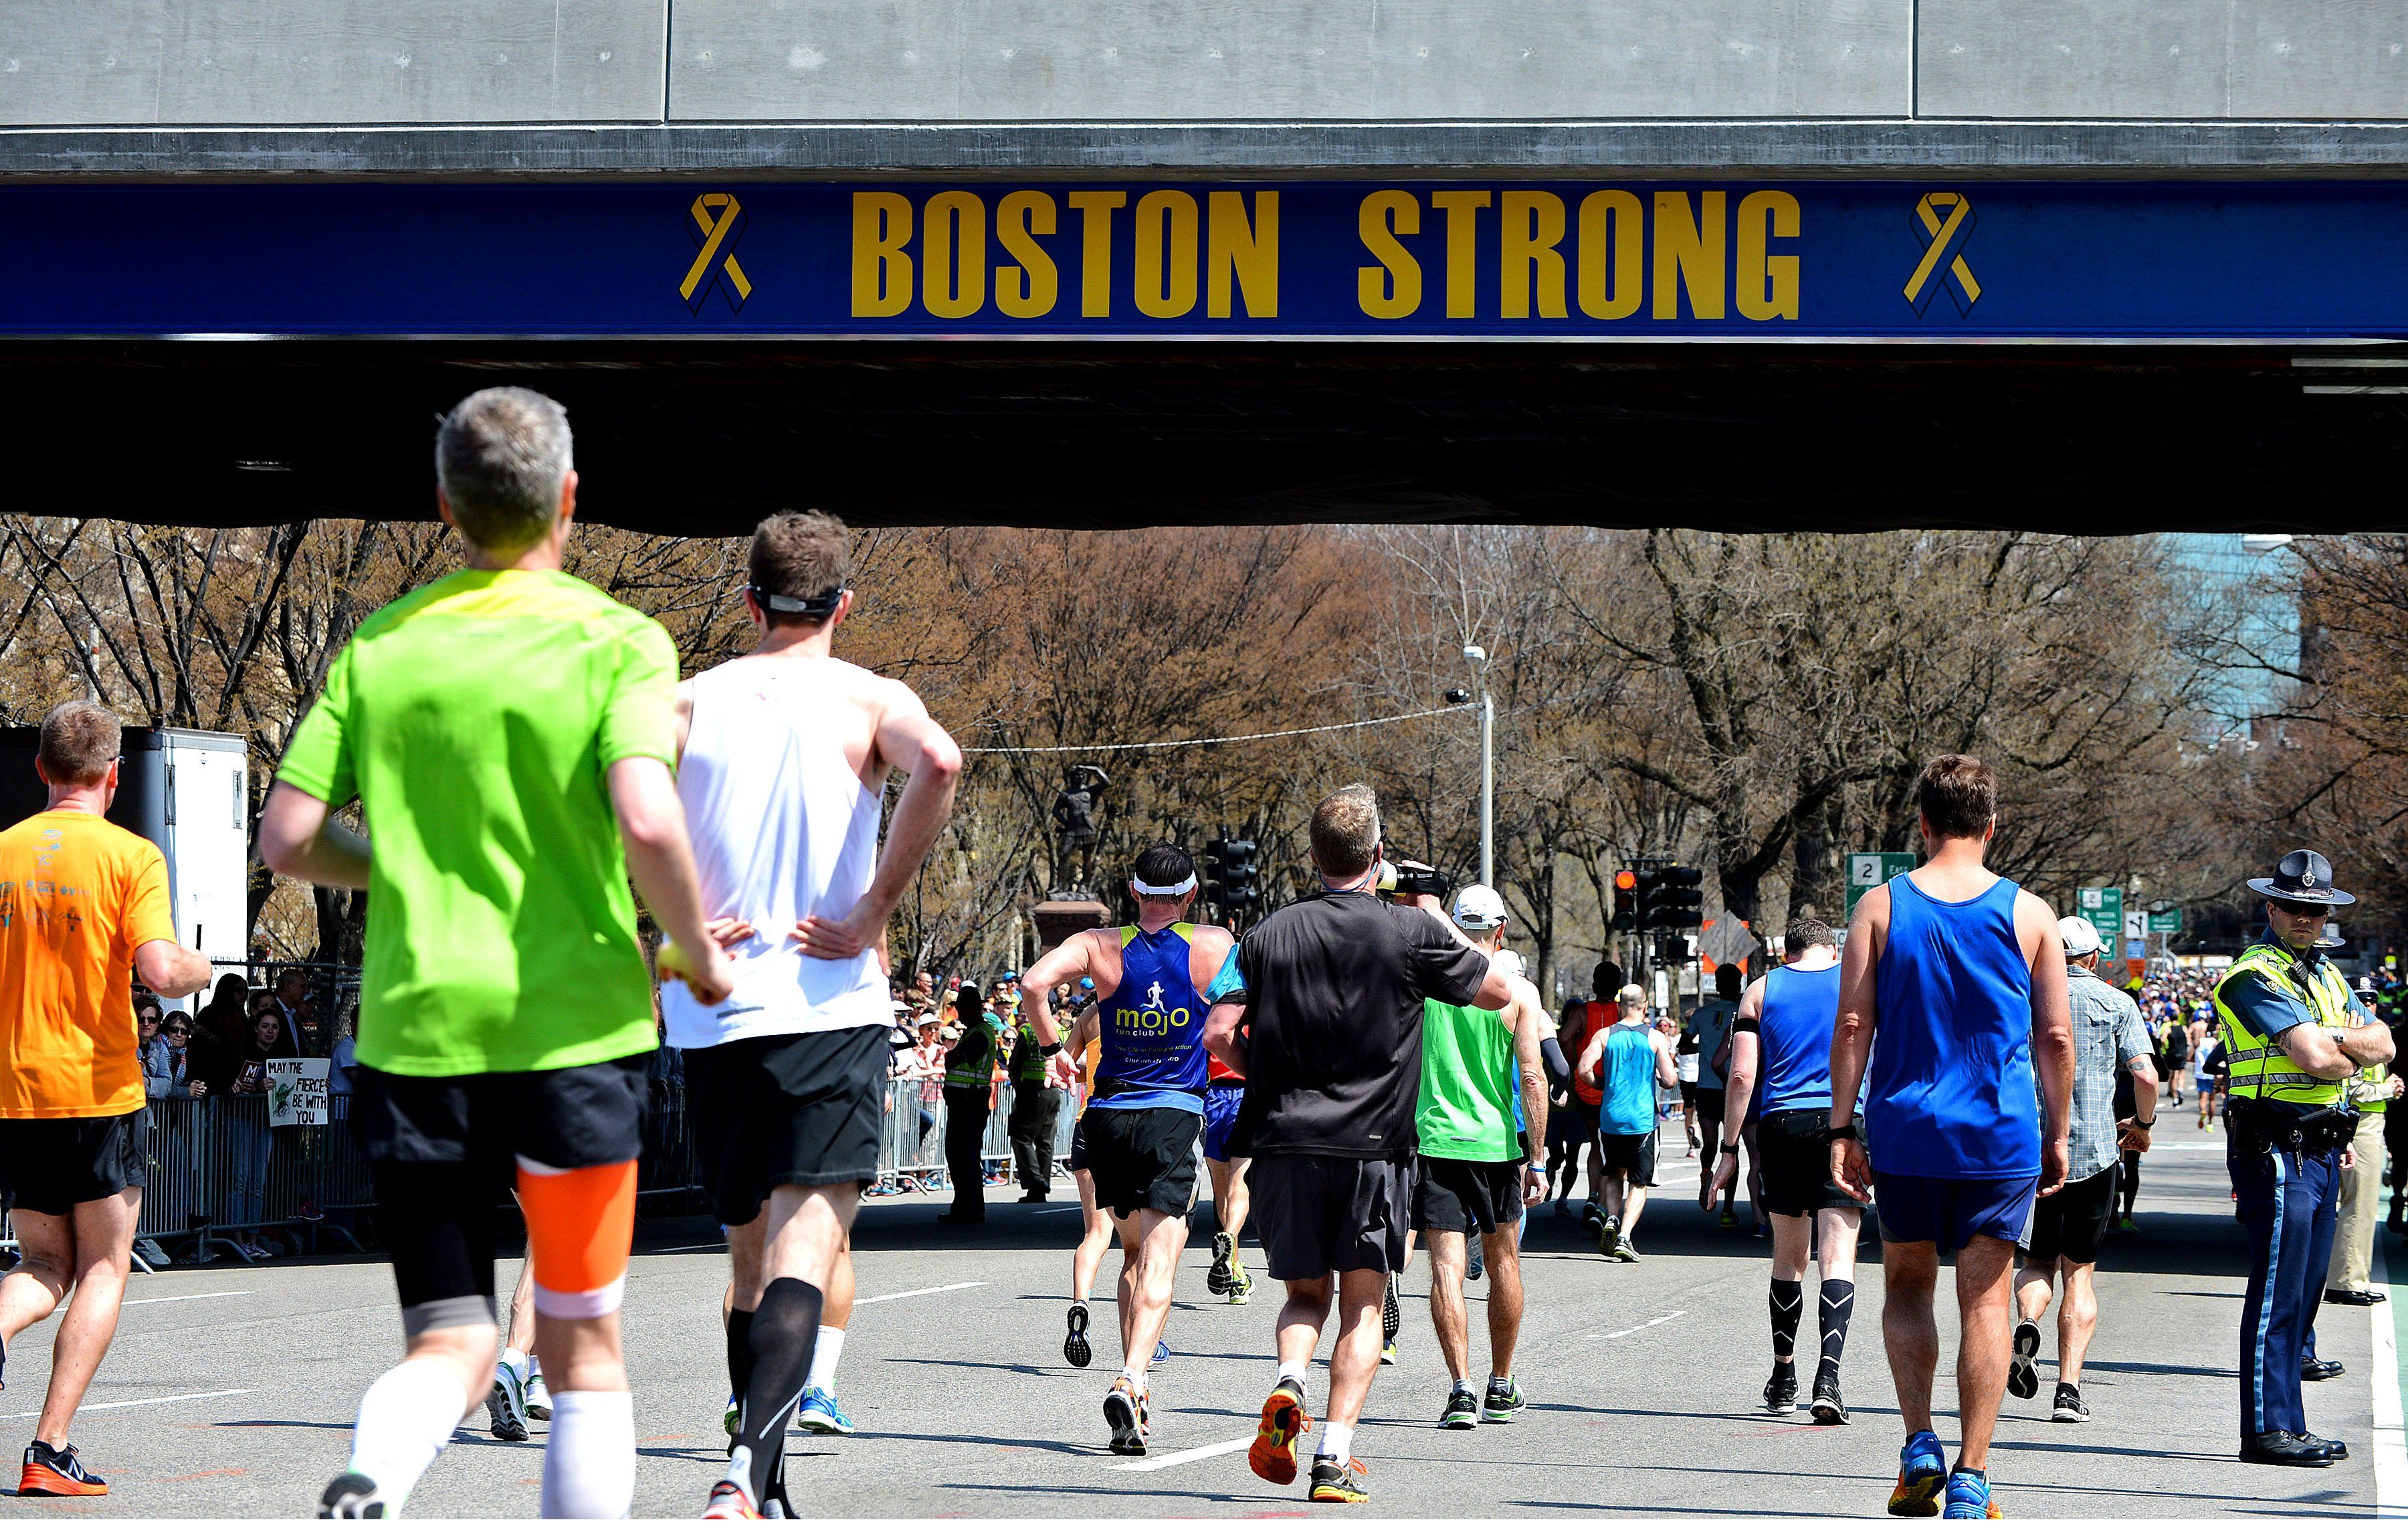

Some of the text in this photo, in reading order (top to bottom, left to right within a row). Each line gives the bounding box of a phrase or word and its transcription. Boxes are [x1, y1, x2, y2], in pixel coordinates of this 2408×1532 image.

[851, 189, 1801, 320] BOSTON STRONG
[1862, 863, 1873, 878] 2
[1116, 1008, 1189, 1036] mojo
[268, 1062, 303, 1074] MAY THE
[296, 1077, 325, 1093] FIERCE
[292, 1093, 327, 1110] BE WITH
[295, 1110, 315, 1125] YOU
